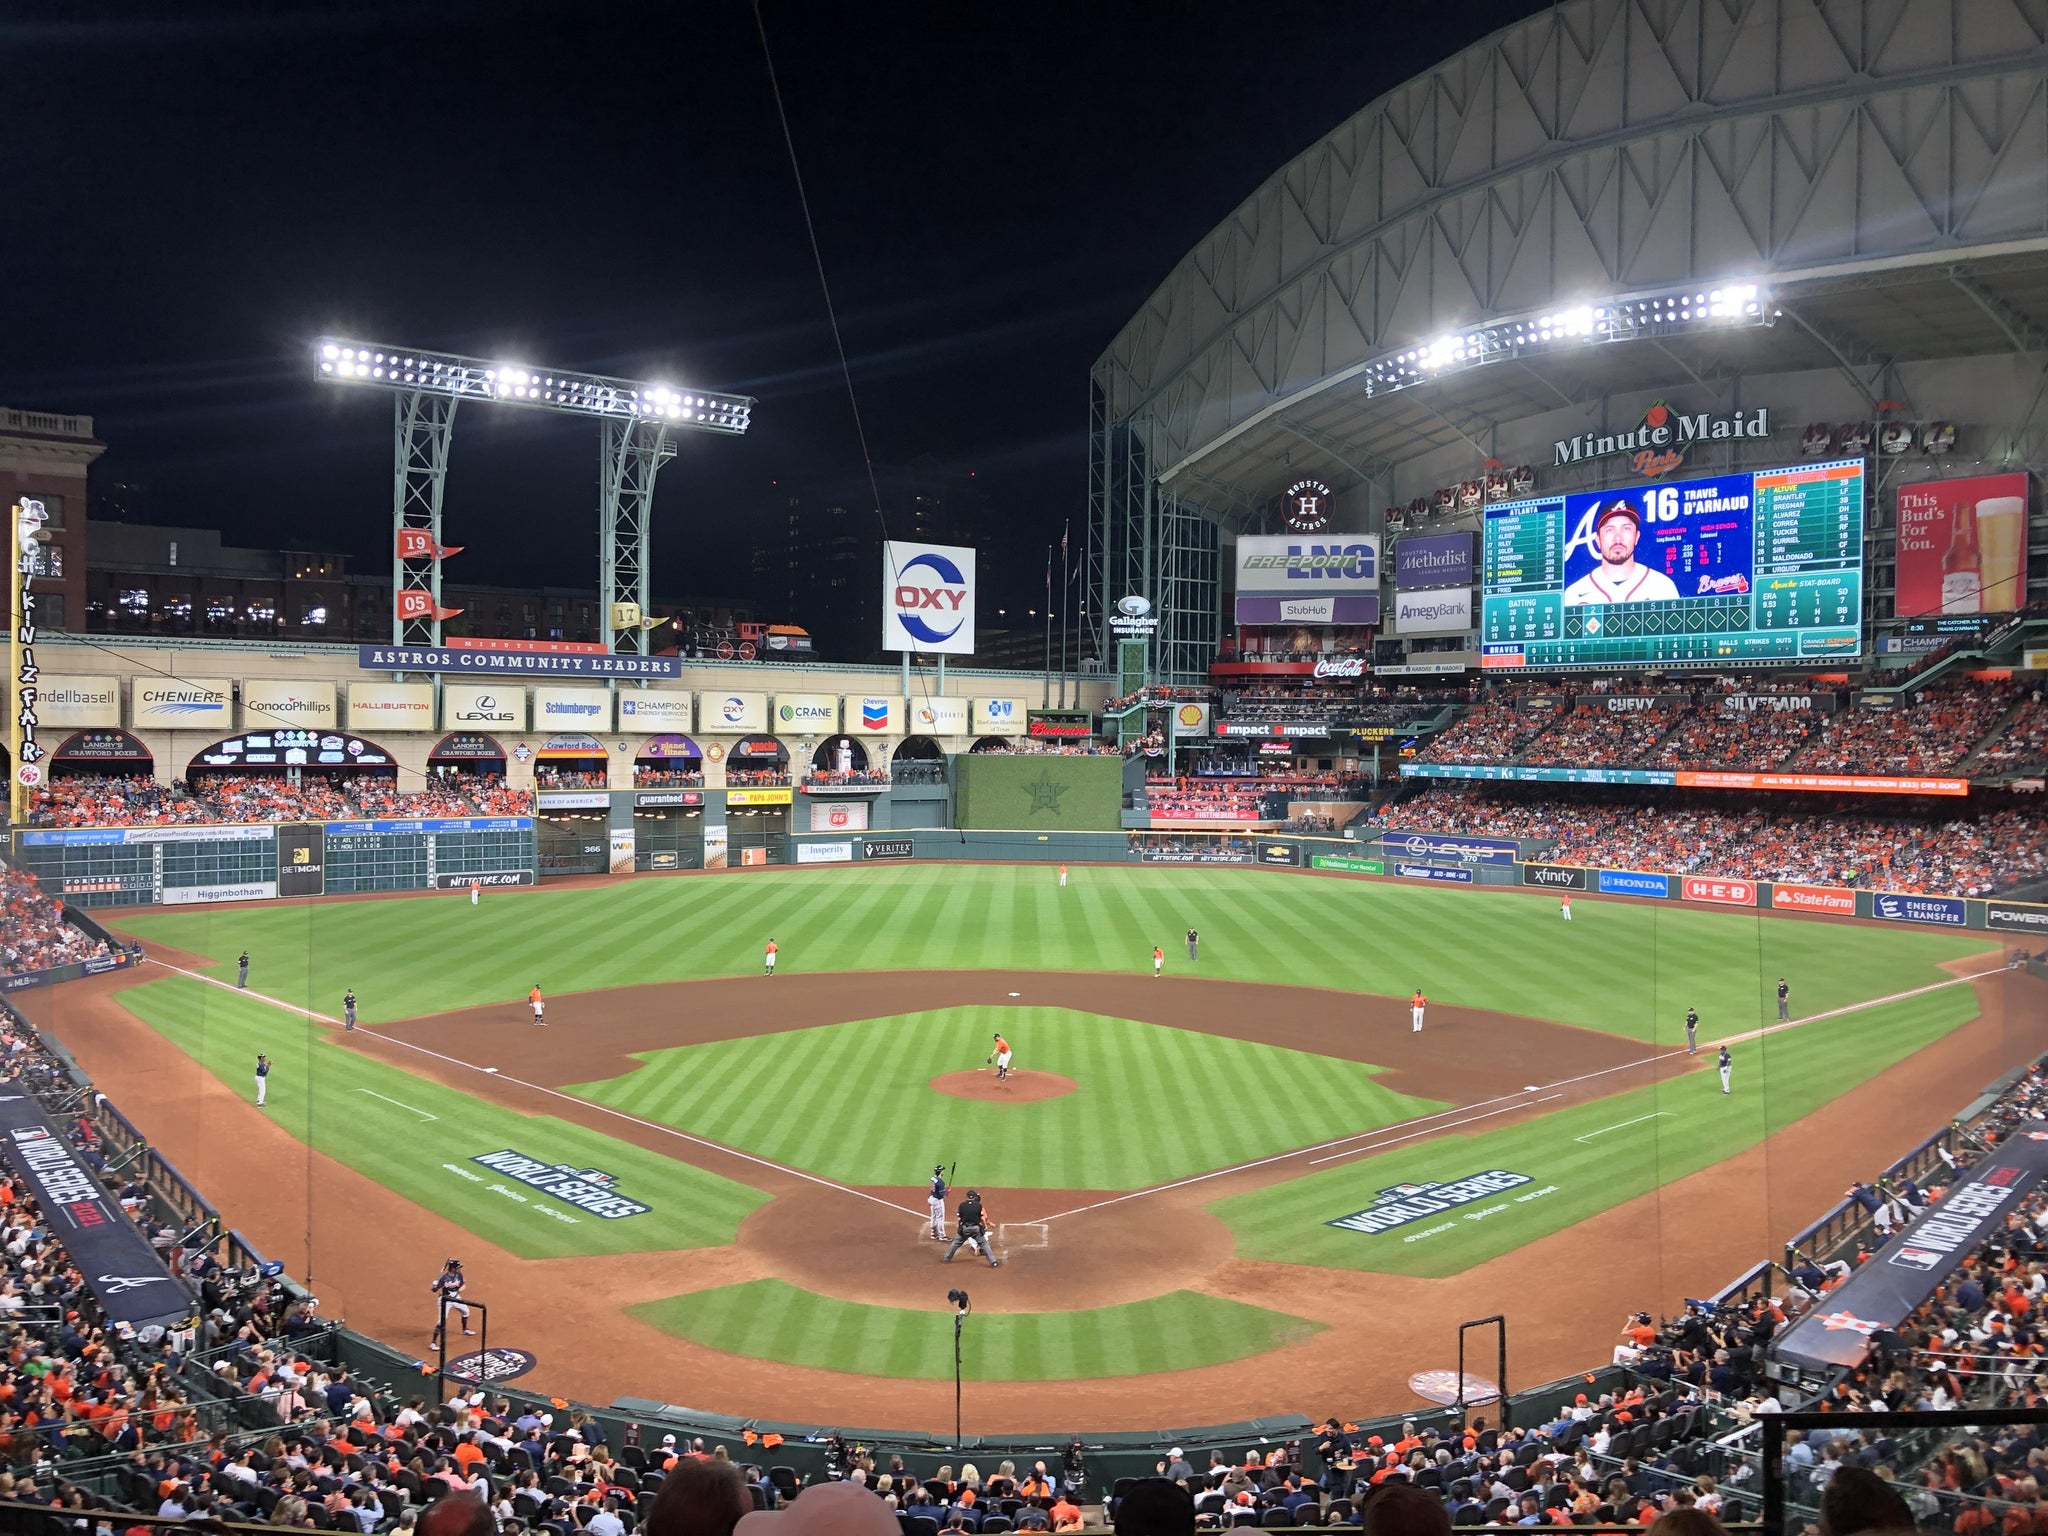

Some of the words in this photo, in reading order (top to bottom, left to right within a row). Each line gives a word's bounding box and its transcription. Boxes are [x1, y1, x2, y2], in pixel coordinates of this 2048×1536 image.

[1553, 424, 1669, 466] Minute
[1683, 409, 1768, 443] Maid
[1632, 449, 1684, 474] Park
[1486, 472, 1506, 490] 34
[1287, 480, 1330, 497] HOUSTON
[1460, 480, 1479, 497] 33
[1684, 488, 1718, 501] TRAVIS
[1773, 485, 1798, 493] ALTUVE
[1773, 492, 1807, 502] BRANTLEY
[1900, 493, 1938, 508] This
[1509, 506, 1539, 516] ATLANTA
[1642, 487, 1680, 524] 16
[1683, 496, 1749, 516] D'ARNAUD
[1773, 501, 1805, 511] BREGMAN
[1385, 507, 1404, 523] 32
[1773, 510, 1801, 519] ALVAREZ
[1900, 507, 1945, 523] Bud's
[1289, 516, 1328, 531] ASTROS
[1498, 517, 1520, 525] ROSARIO
[1773, 520, 1799, 528] CORREA
[1772, 528, 1799, 537] TUCKER
[1900, 523, 1928, 537] For
[407, 536, 426, 551] 19
[1772, 537, 1801, 546] GURRIEL
[1900, 537, 1936, 552] You.
[1401, 549, 1428, 557] HOUSTON
[1772, 546, 1786, 554] SIRI
[1247, 556, 1358, 569] FREEPORT
[1288, 543, 1375, 580] LNG
[1401, 549, 1467, 570] Methodist
[1772, 552, 1814, 562] MALDONADO
[1497, 569, 1523, 577] D'ARNAUD
[1772, 565, 1801, 573] URQUIDY
[1697, 573, 1746, 598] Braves
[1799, 578, 1842, 588] STAT-BOARD
[895, 586, 968, 611] OXY
[1763, 592, 1777, 601] ERA
[404, 595, 426, 611] 05
[1508, 599, 1537, 608] BATTING
[617, 608, 635, 622] 17
[1286, 605, 1327, 615] StubHub
[1400, 602, 1466, 621] AmegyBank
[1109, 616, 1160, 627] Gallagher
[465, 641, 535, 650] MINUTE
[551, 644, 595, 653] MAID
[1902, 637, 1952, 647] CHAMPI
[1489, 645, 1519, 654] BRAVES
[460, 654, 584, 670] COMMUNITY
[592, 659, 672, 673] LEADERS
[39, 691, 115, 704] ndellbasell
[143, 691, 224, 703] CHENIERE
[249, 700, 332, 714] ConocoPhillips
[352, 703, 430, 711] HALLIBURTON
[545, 701, 603, 717] Schlumberger
[637, 701, 688, 710] CHAMPION
[1607, 697, 1656, 712] CHEVY
[456, 712, 516, 721] LEXUS
[795, 707, 833, 717] CRANE
[20, 690, 38, 763] FAIR
[1030, 722, 1091, 736] Budweiser
[1226, 724, 1271, 736] impact
[1283, 725, 1327, 737] impact
[1351, 728, 1395, 736] PLUCKERS
[547, 742, 580, 750] Crawford
[581, 742, 600, 750] Bock
[661, 741, 687, 752] planet
[663, 748, 691, 757] fitness
[1722, 775, 1756, 783] ELEPHANT
[1853, 780, 1898, 788] INSPECTION
[640, 794, 684, 806] guaranteed
[749, 794, 765, 802] PAPA
[766, 793, 789, 802] JOHN'S
[831, 815, 847, 823] 66
[341, 836, 353, 845] ATL
[706, 839, 726, 848] WM
[340, 843, 354, 851] HOU
[584, 845, 602, 854] 366
[612, 843, 634, 851] WM
[810, 845, 845, 856] Insperity
[875, 844, 911, 854] VERITEX
[427, 836, 436, 887] AMERICAN
[1153, 854, 1194, 862] NITTOTIRE.COM
[1200, 855, 1243, 863] NITTOTIRE.COM
[1462, 855, 1478, 863] 370
[282, 865, 321, 875] BETMGM
[1326, 860, 1349, 869] National
[1350, 862, 1359, 870] Car
[1359, 863, 1377, 872] Rental
[154, 845, 162, 902] NATIONAL
[1534, 868, 1575, 886] xfinity
[450, 874, 521, 888] NITTOTIRE.COM
[1612, 877, 1666, 891] HONDA
[197, 887, 265, 901] Higginbotham
[1692, 884, 1746, 900] H-E-B
[1906, 901, 1948, 913] ENERGY
[1907, 911, 1959, 923] TRANSFER
[14, 977, 30, 987] MLB
[15, 1137, 75, 1171] WORLD
[36, 1168, 100, 1204] SERIES
[475, 1151, 569, 1185] WORLD
[544, 1180, 646, 1219] SERIES
[1332, 1196, 1451, 1233] WORLD
[1433, 1170, 1531, 1203] SERIES
[1942, 1182, 2014, 1218] SERIES
[70, 1202, 105, 1228] 2021
[1903, 1212, 1984, 1252] WORLD
